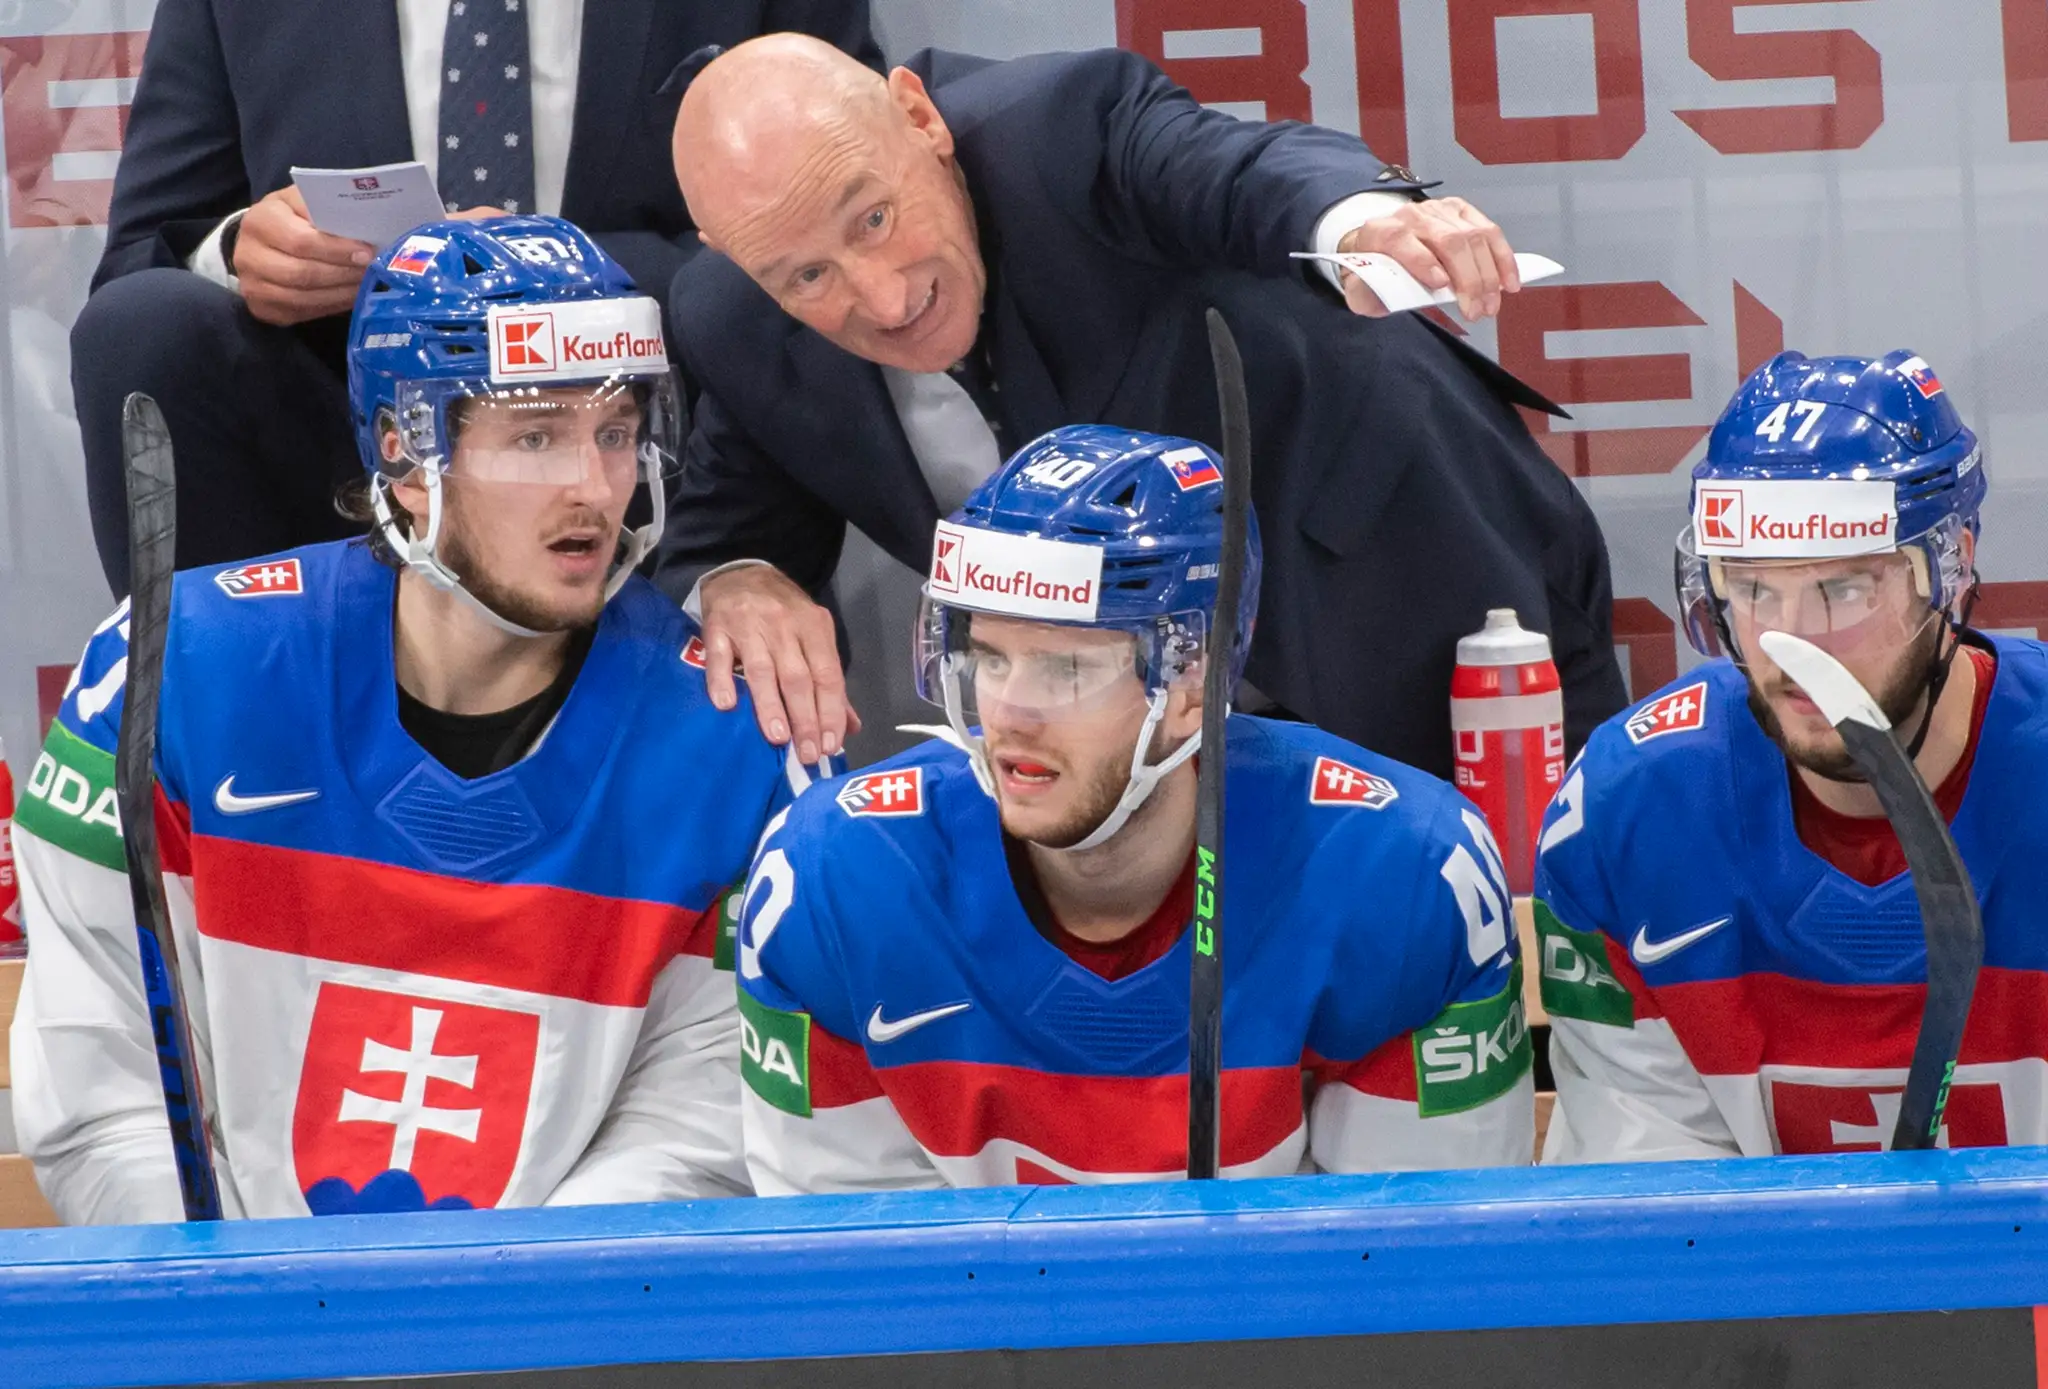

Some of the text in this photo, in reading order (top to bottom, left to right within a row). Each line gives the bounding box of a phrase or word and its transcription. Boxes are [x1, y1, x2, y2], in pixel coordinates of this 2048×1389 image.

[1114, 0, 2048, 166] BIOS
[562, 332, 663, 362] Kaufland
[1755, 400, 1826, 443] 47
[1023, 455, 1096, 489] 40
[1750, 514, 1889, 540] Kaufland
[964, 562, 1092, 605] Kaufland
[1197, 845, 1215, 956] CCM
